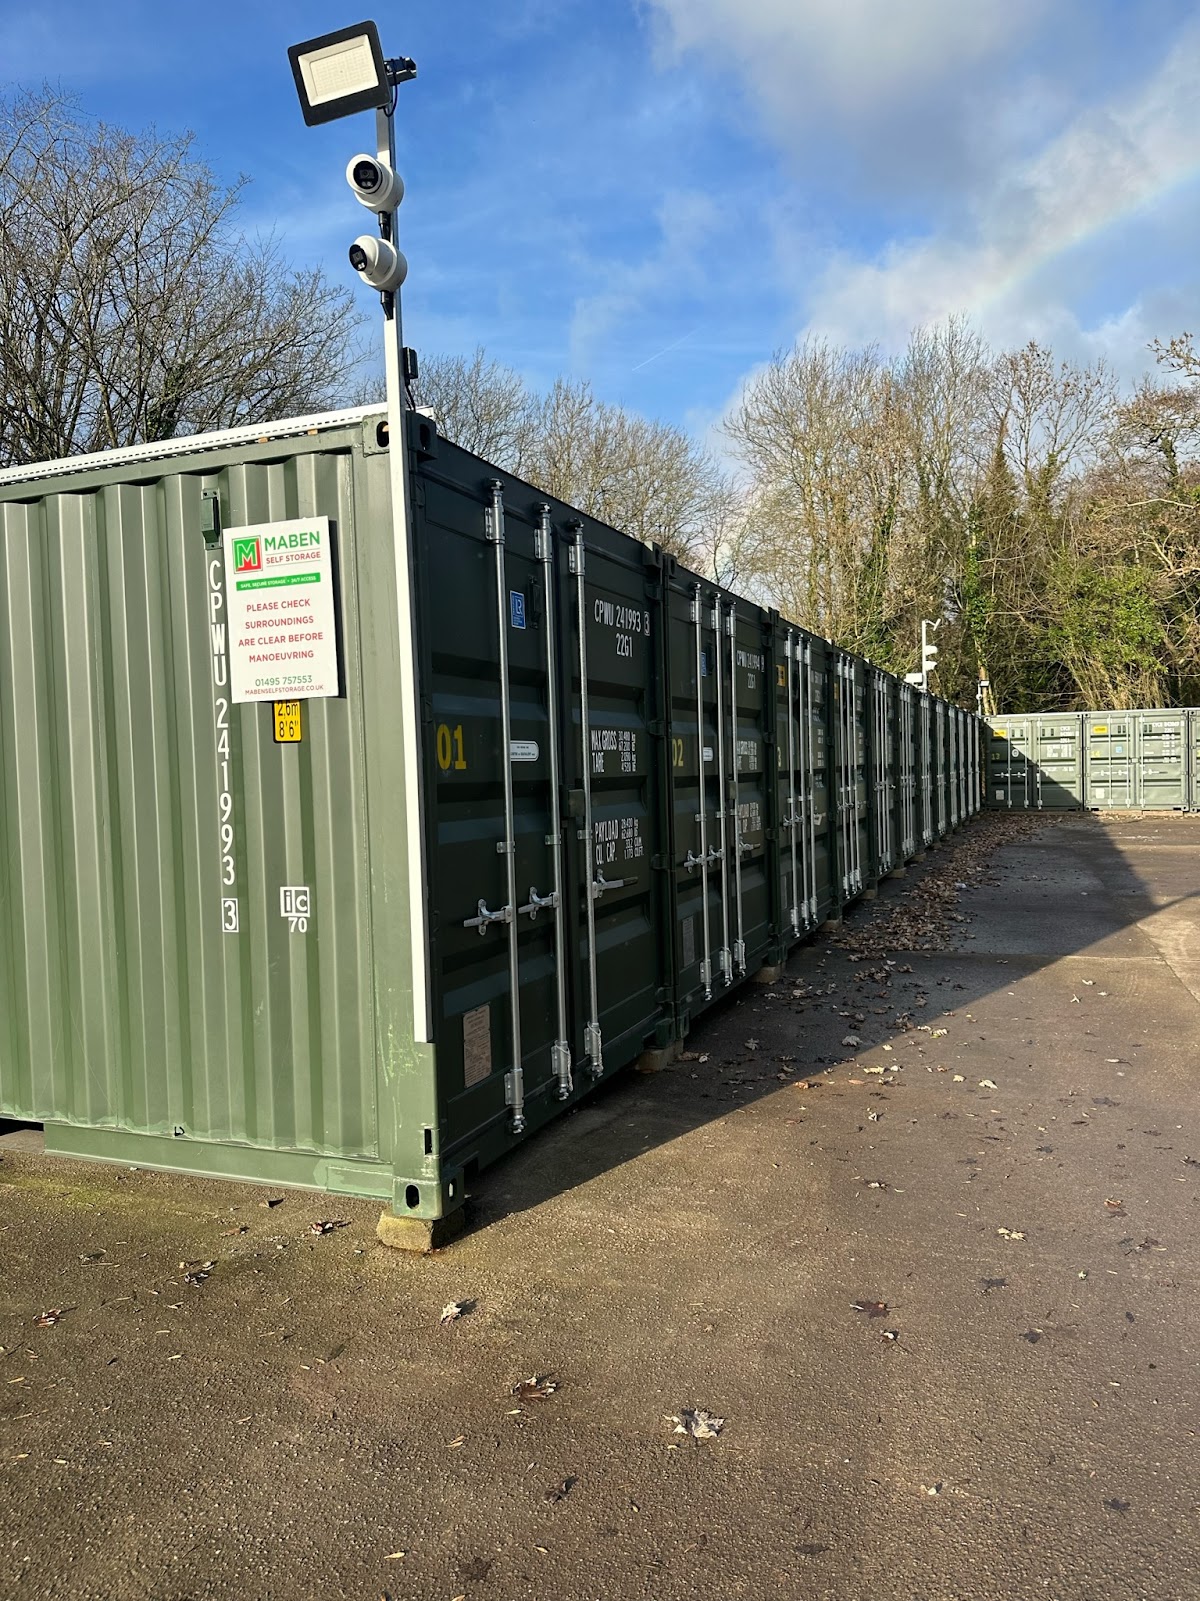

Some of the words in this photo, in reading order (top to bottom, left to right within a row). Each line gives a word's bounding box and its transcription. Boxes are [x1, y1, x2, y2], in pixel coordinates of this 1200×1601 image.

[264, 531, 320, 552] MABEN
[266, 554, 284, 565] SELF
[285, 551, 321, 563] STORAGE
[246, 601, 279, 613] PLEASE
[281, 598, 311, 609] CHECK
[209, 560, 227, 687] CPWU
[245, 615, 314, 630] SURROUNDINGS
[594, 599, 614, 626] CPWU
[616, 605, 641, 632] 241993
[644, 612, 650, 636] 3
[238, 638, 256, 647] ARE
[257, 635, 286, 645] CLEAR
[288, 632, 324, 643] BEFORE
[616, 633, 633, 657] 22G1
[249, 650, 314, 663] MANOEUVRING
[245, 685, 324, 695] MABENSELFSTORAGE.CO.UK
[255, 677, 280, 687] 01495
[282, 674, 313, 685] 757553
[437, 723, 467, 770] 01
[590, 729, 602, 751] MAX
[602, 730, 617, 750] GROSS
[591, 752, 605, 773] TARE
[672, 738, 684, 767] 02
[215, 697, 235, 886] 241993
[595, 819, 619, 843] PAYLOAD
[606, 841, 618, 862] CAP.
[288, 917, 307, 933] 70
